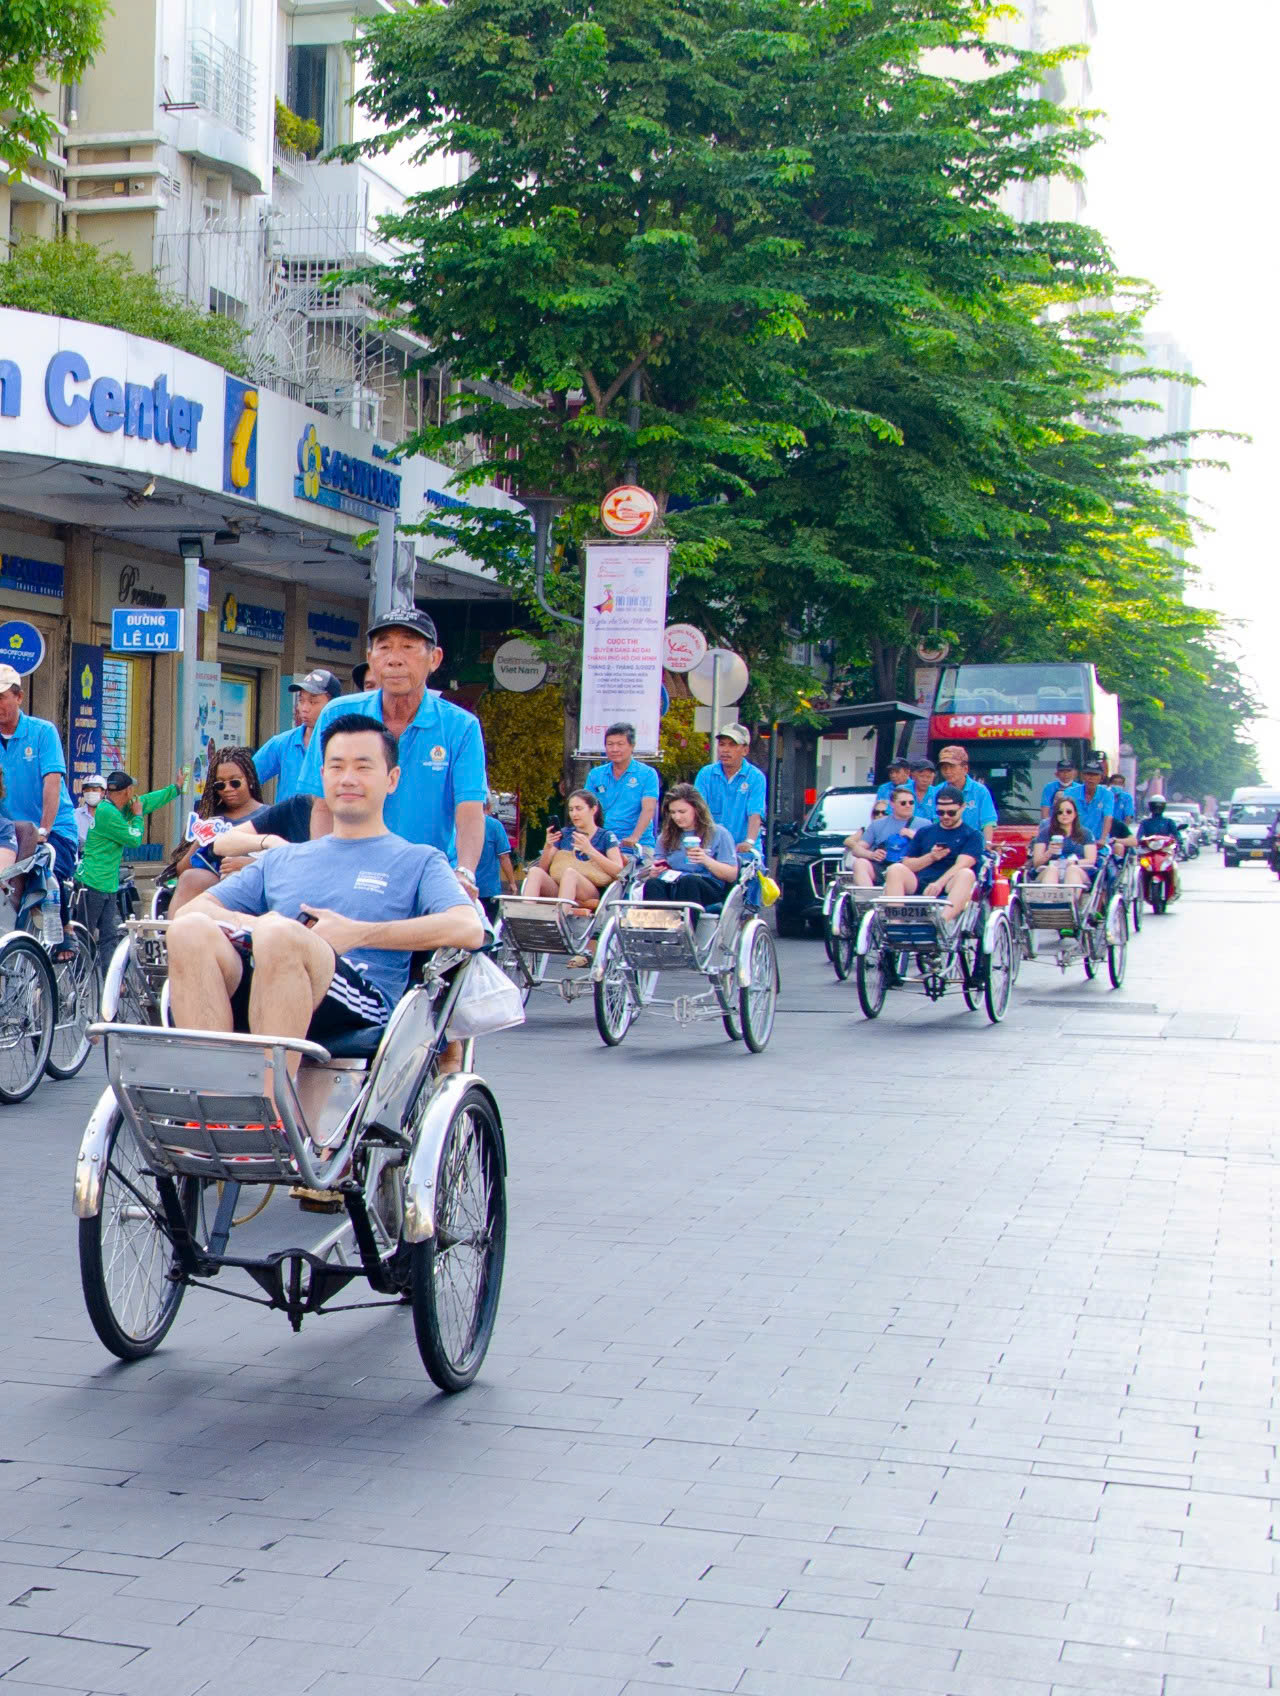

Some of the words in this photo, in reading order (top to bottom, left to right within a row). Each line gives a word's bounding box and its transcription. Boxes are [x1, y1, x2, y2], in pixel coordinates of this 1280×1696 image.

[45, 351, 203, 452] Center
[127, 613, 166, 626] ĐƯỜNG
[123, 630, 142, 646] LÊ
[145, 632, 169, 649] LỢI
[949, 715, 976, 728] HO
[980, 714, 1013, 726] CHI
[1017, 714, 1067, 726] MINH
